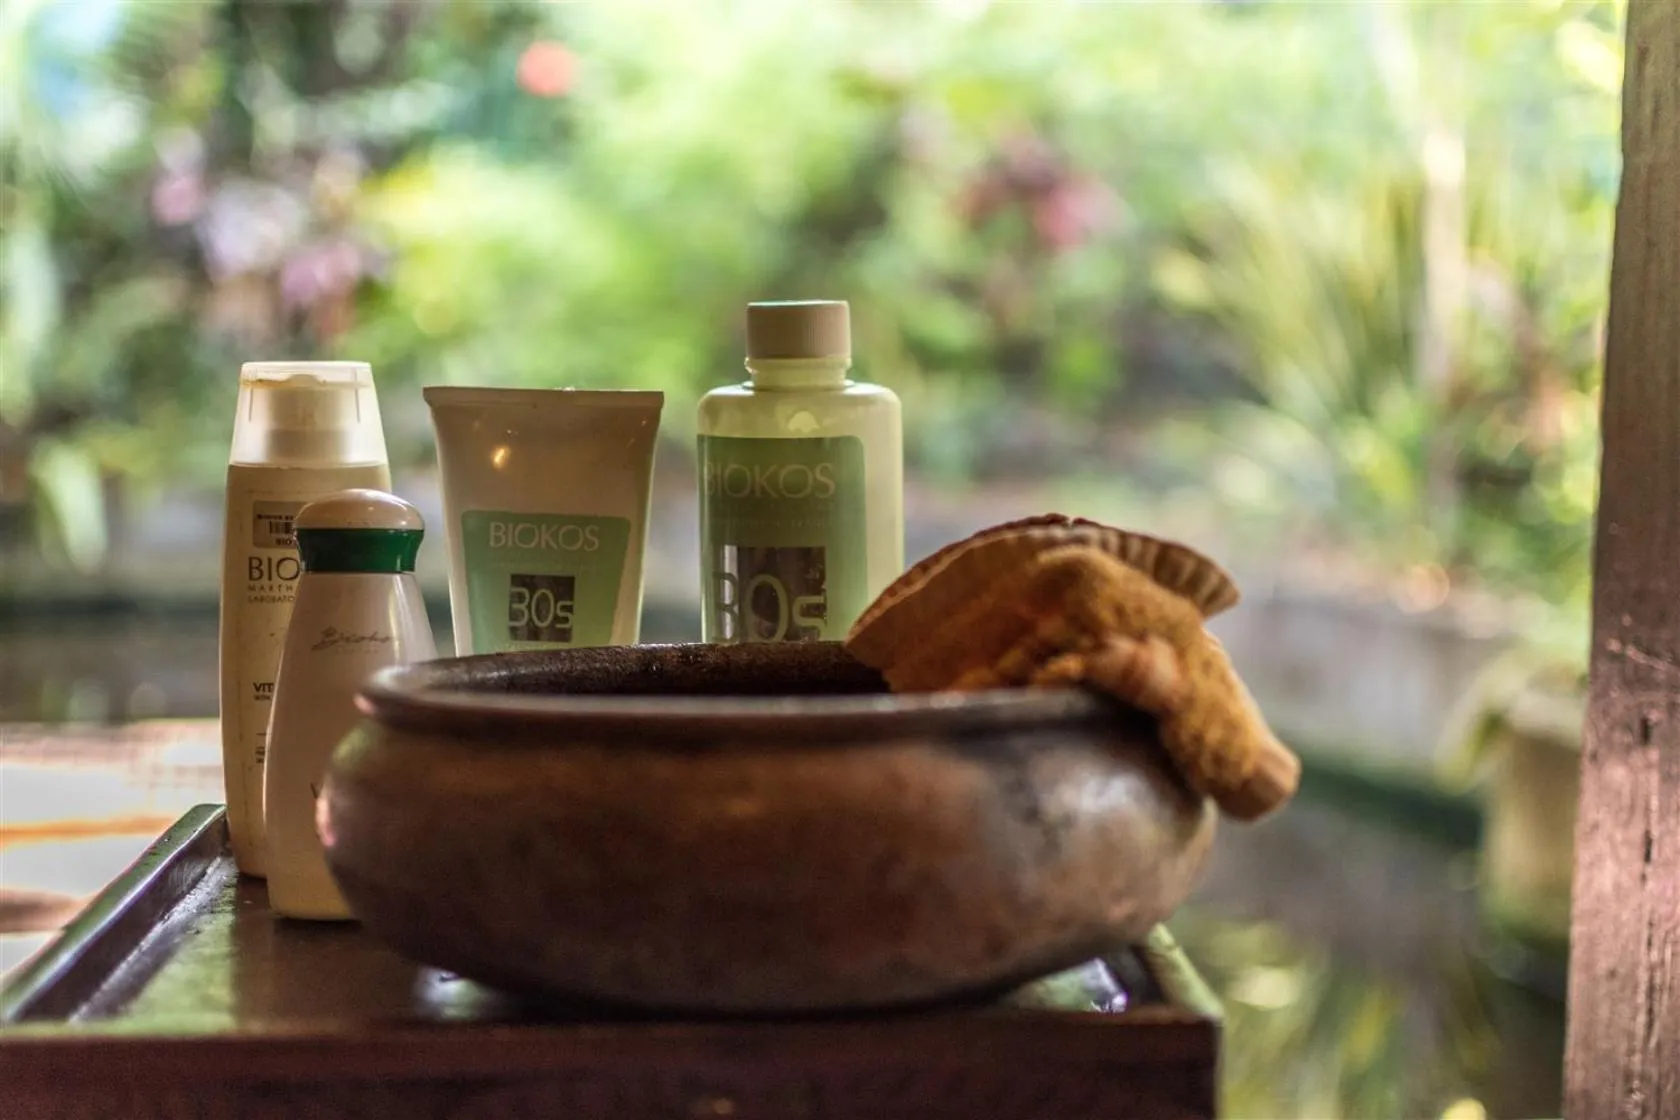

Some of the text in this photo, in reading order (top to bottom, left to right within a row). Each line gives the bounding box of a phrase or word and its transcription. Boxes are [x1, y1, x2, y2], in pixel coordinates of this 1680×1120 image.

[703, 461, 837, 499] BIOKOS
[489, 521, 600, 551] BIOKOS
[508, 586, 575, 629] 30s
